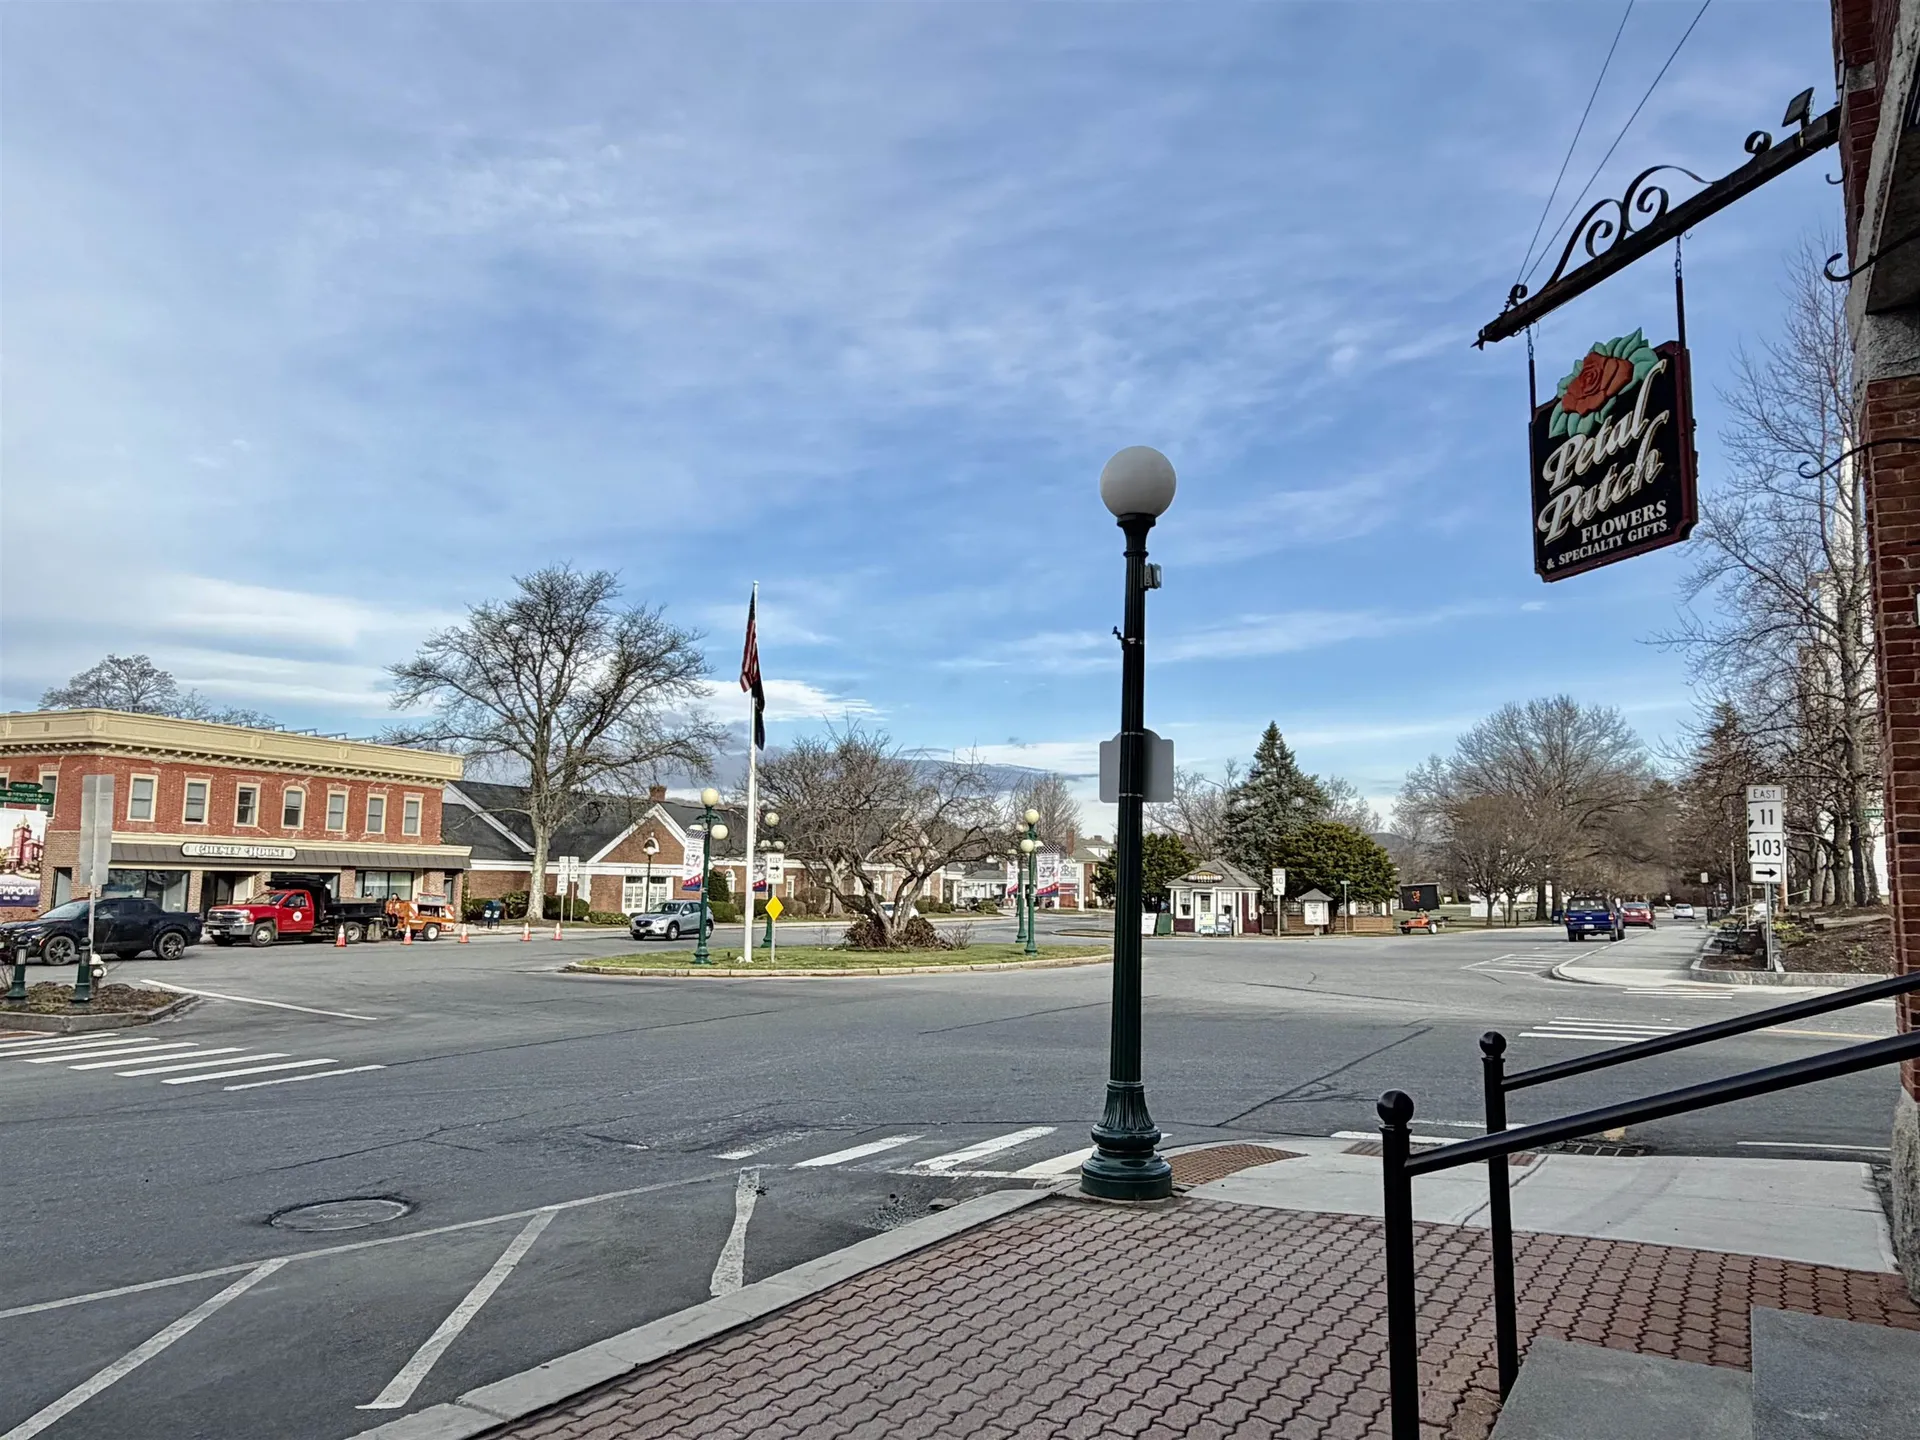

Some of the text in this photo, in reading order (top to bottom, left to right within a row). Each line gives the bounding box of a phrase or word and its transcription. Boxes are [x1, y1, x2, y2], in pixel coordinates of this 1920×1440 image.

[1542, 359, 1668, 495] Petal
[1537, 410, 1669, 546] Patch
[1581, 499, 1667, 544] FLOWERS
[1546, 521, 1668, 569] & SPECIALTY GIFTS
[1753, 789, 1776, 799] EAST
[1760, 808, 1774, 825] 11
[244, 847, 285, 858] HOUSE
[1755, 839, 1781, 856] 103
